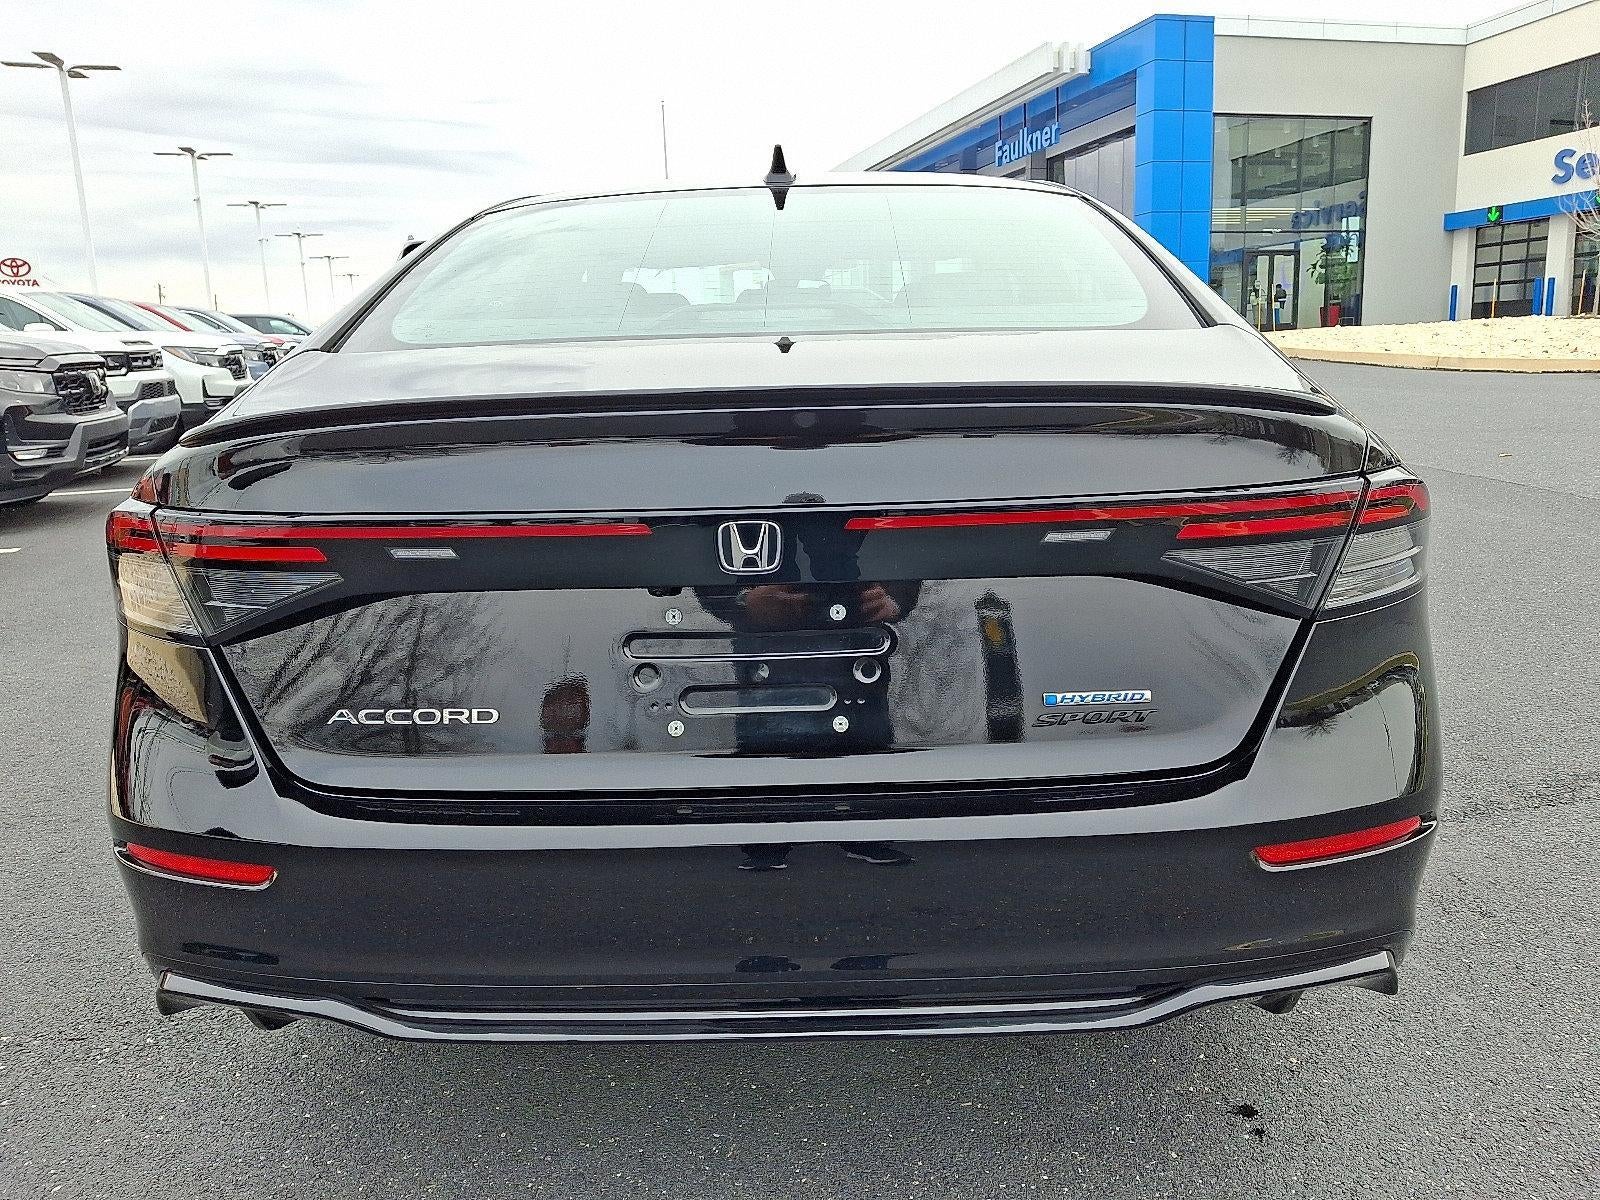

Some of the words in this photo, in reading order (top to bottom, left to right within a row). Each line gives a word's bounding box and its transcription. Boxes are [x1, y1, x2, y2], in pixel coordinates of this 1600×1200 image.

[994, 121, 1060, 167] Faulkner
[1060, 693, 1145, 703] HYBRID
[326, 708, 499, 725] ACCORD
[1032, 708, 1157, 727] SPORT
